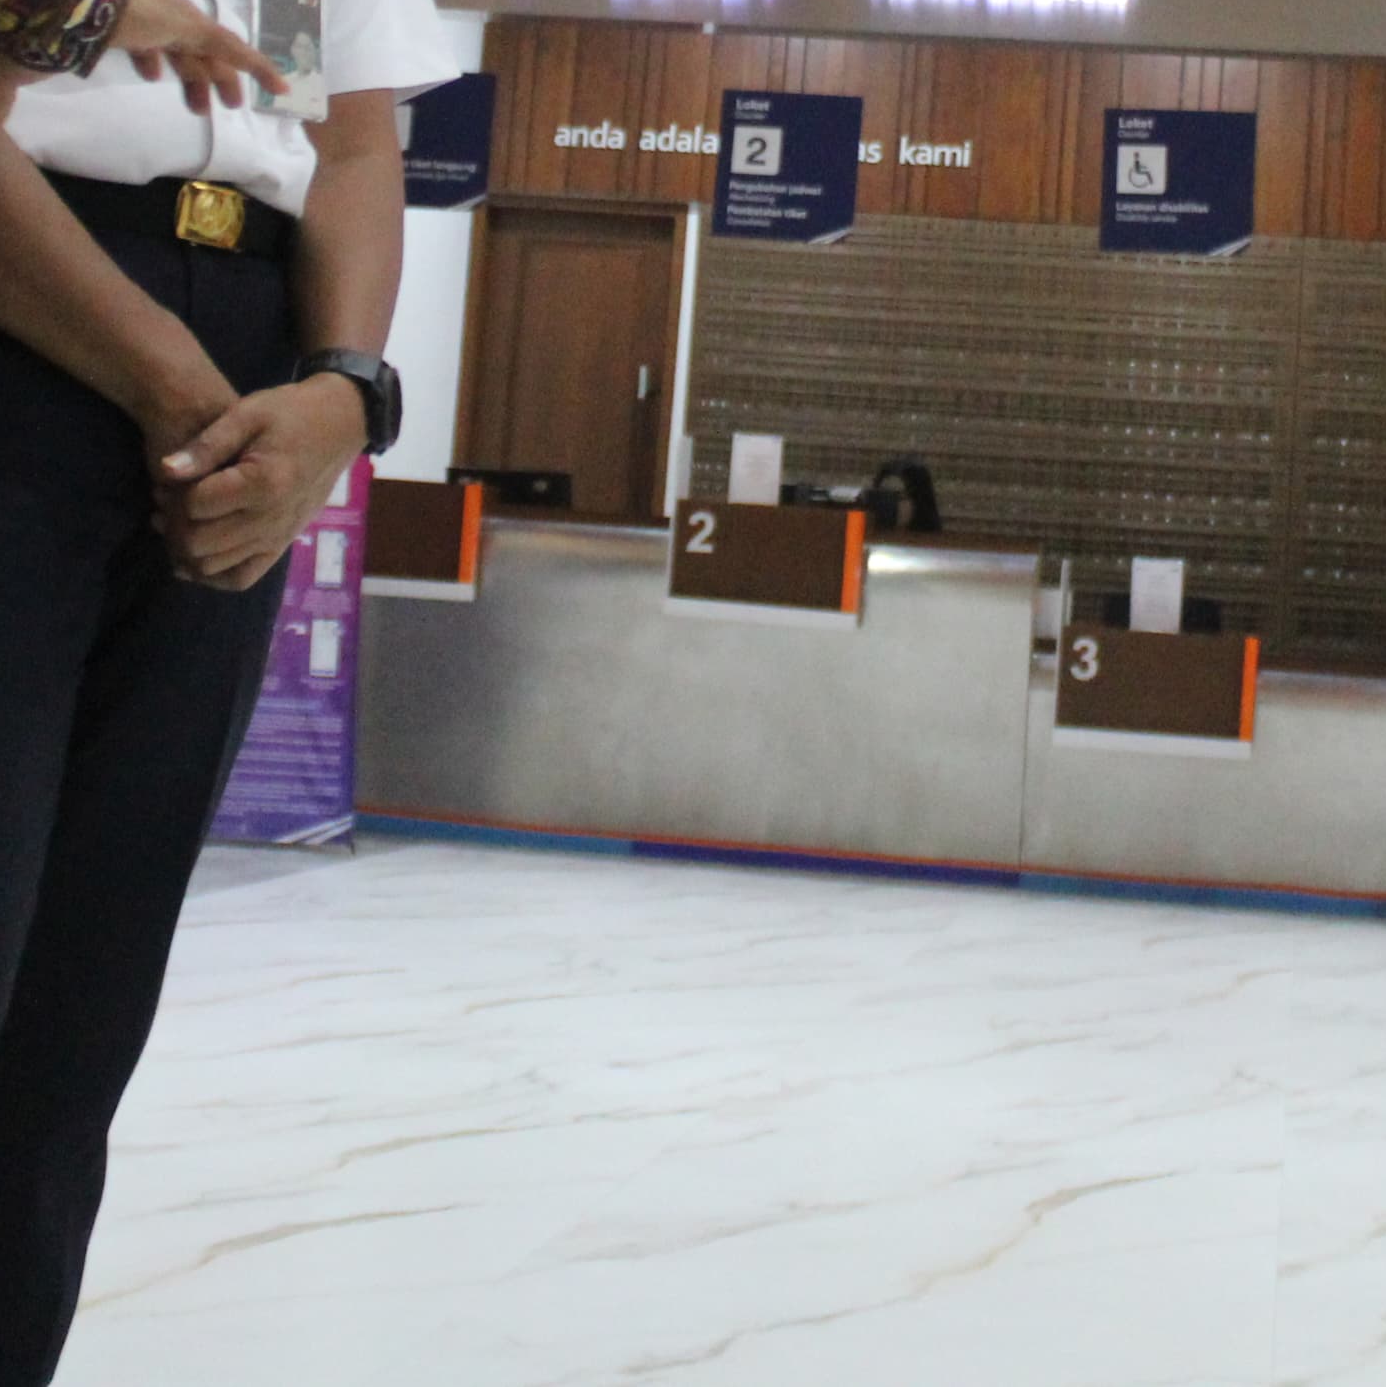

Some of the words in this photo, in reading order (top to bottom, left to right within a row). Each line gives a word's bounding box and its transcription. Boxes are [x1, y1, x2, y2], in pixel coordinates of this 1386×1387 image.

[554, 119, 626, 150] anda
[639, 123, 721, 154] adala
[899, 134, 972, 167] kami
[1118, 117, 1154, 130] Loket
[745, 136, 768, 166] 2
[687, 511, 715, 553] 2
[1071, 638, 1098, 681] 3
